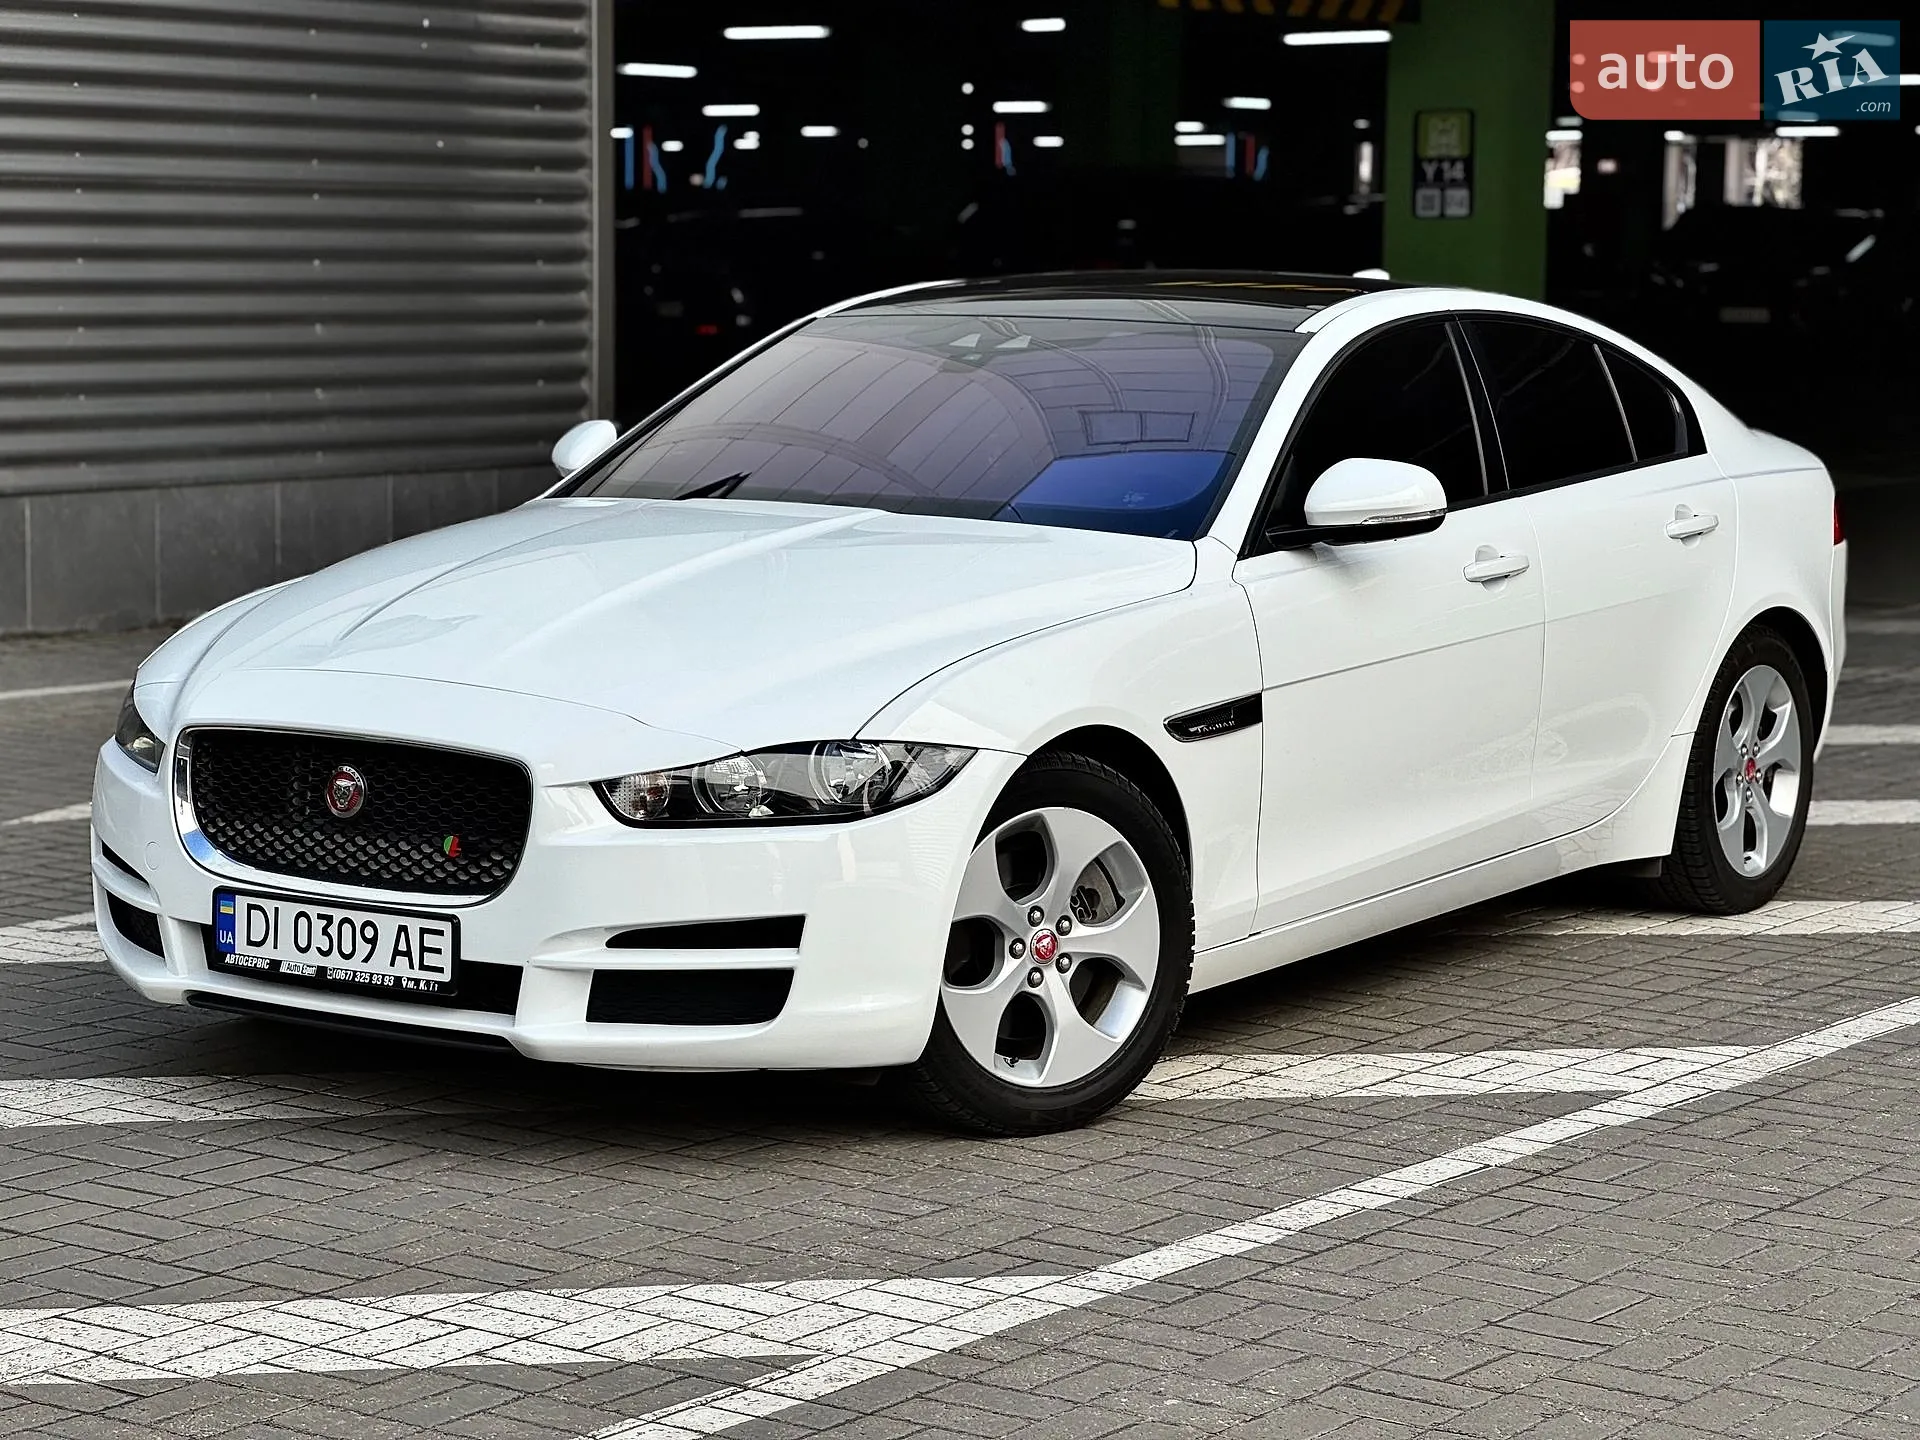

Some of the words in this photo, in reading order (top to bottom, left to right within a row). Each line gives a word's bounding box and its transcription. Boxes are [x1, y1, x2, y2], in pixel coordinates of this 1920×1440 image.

[219, 930, 234, 945] UA
[245, 902, 280, 950] DI
[293, 910, 379, 964] 0309
[389, 924, 445, 974] AE
[332, 968, 354, 981] (067)
[355, 971, 370, 983] 325
[371, 974, 383, 985] 93
[383, 975, 395, 986] 93
